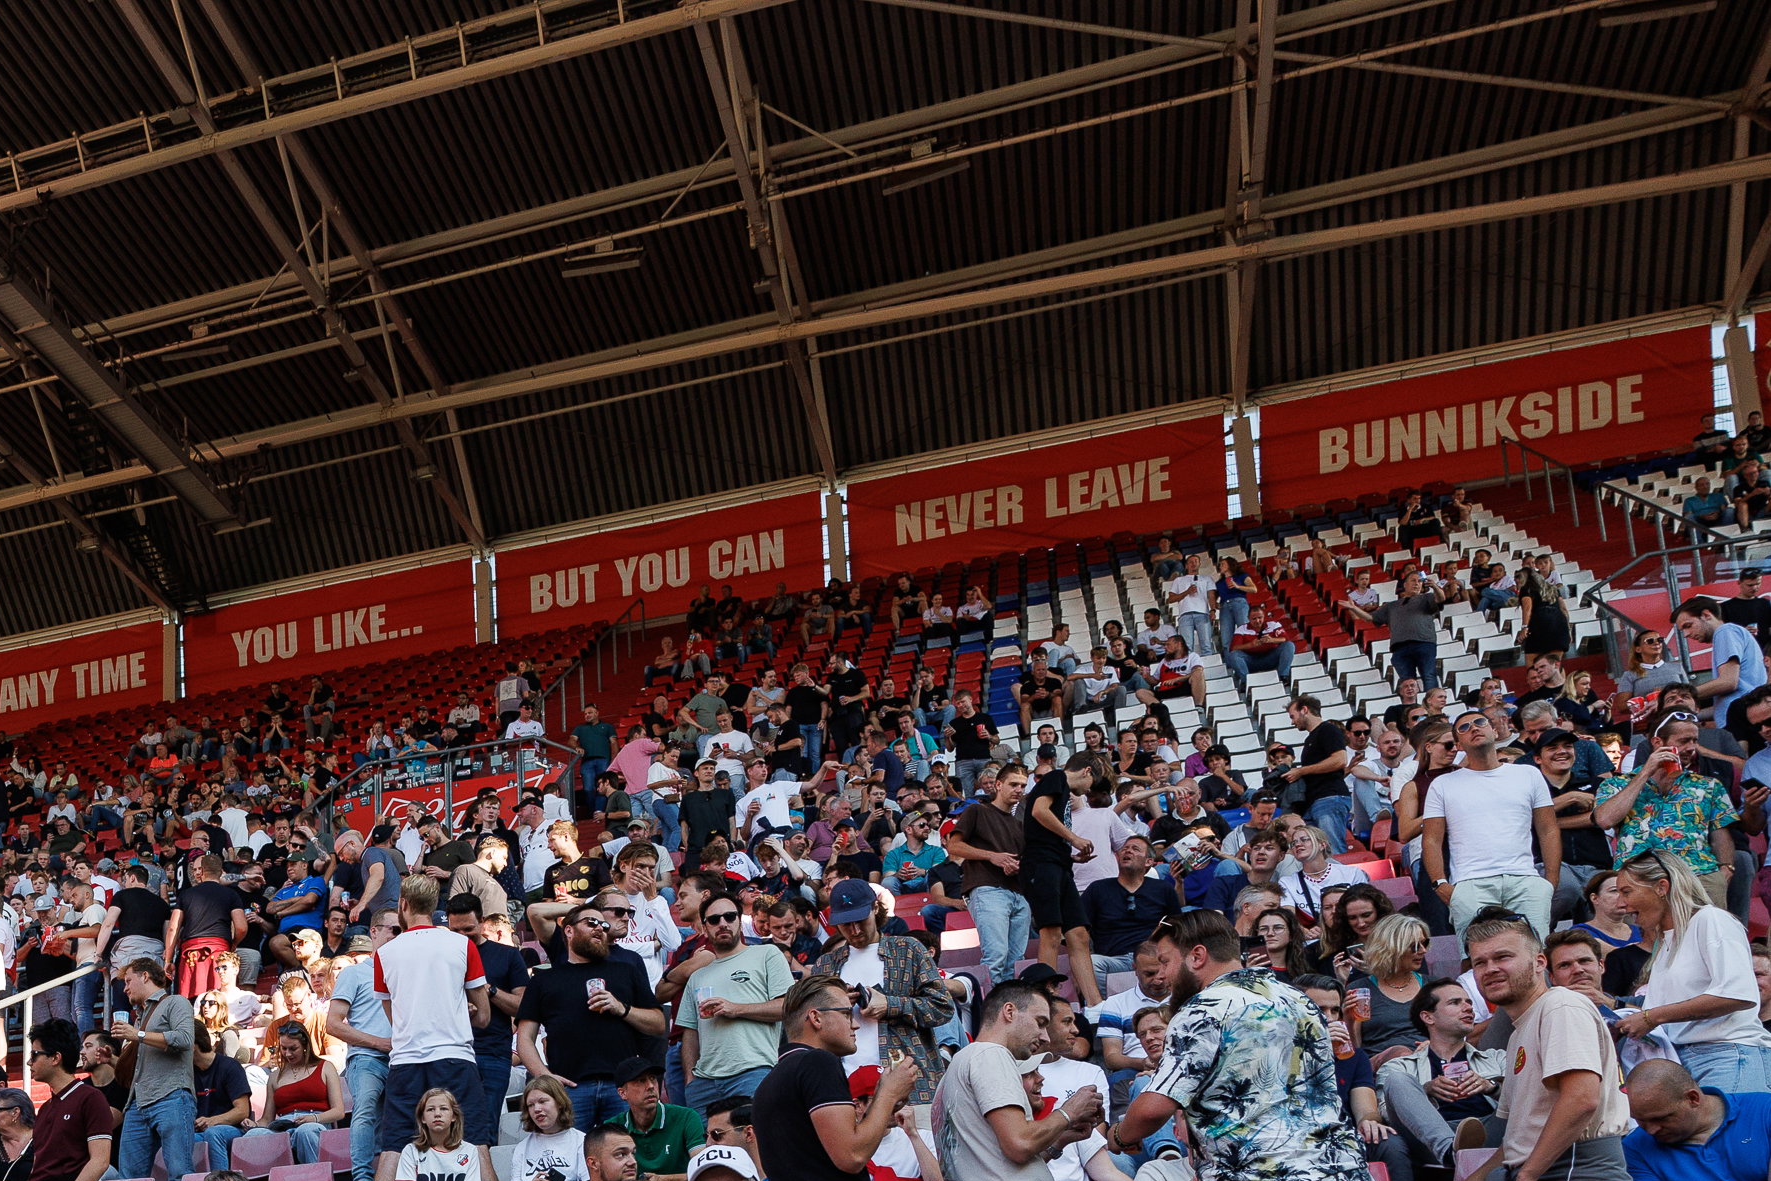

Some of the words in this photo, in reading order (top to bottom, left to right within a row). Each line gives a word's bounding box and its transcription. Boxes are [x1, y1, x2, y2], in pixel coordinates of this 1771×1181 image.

[1320, 374, 1644, 474] BUNNIKSIDE
[896, 484, 1025, 546] NEVER
[1046, 456, 1173, 519] LEAVE
[530, 565, 600, 613] BUT
[614, 546, 689, 594] YOU
[708, 528, 785, 578] CAN
[72, 652, 147, 699] TIME
[232, 621, 297, 667] YOU
[314, 604, 423, 654] LIKE...
